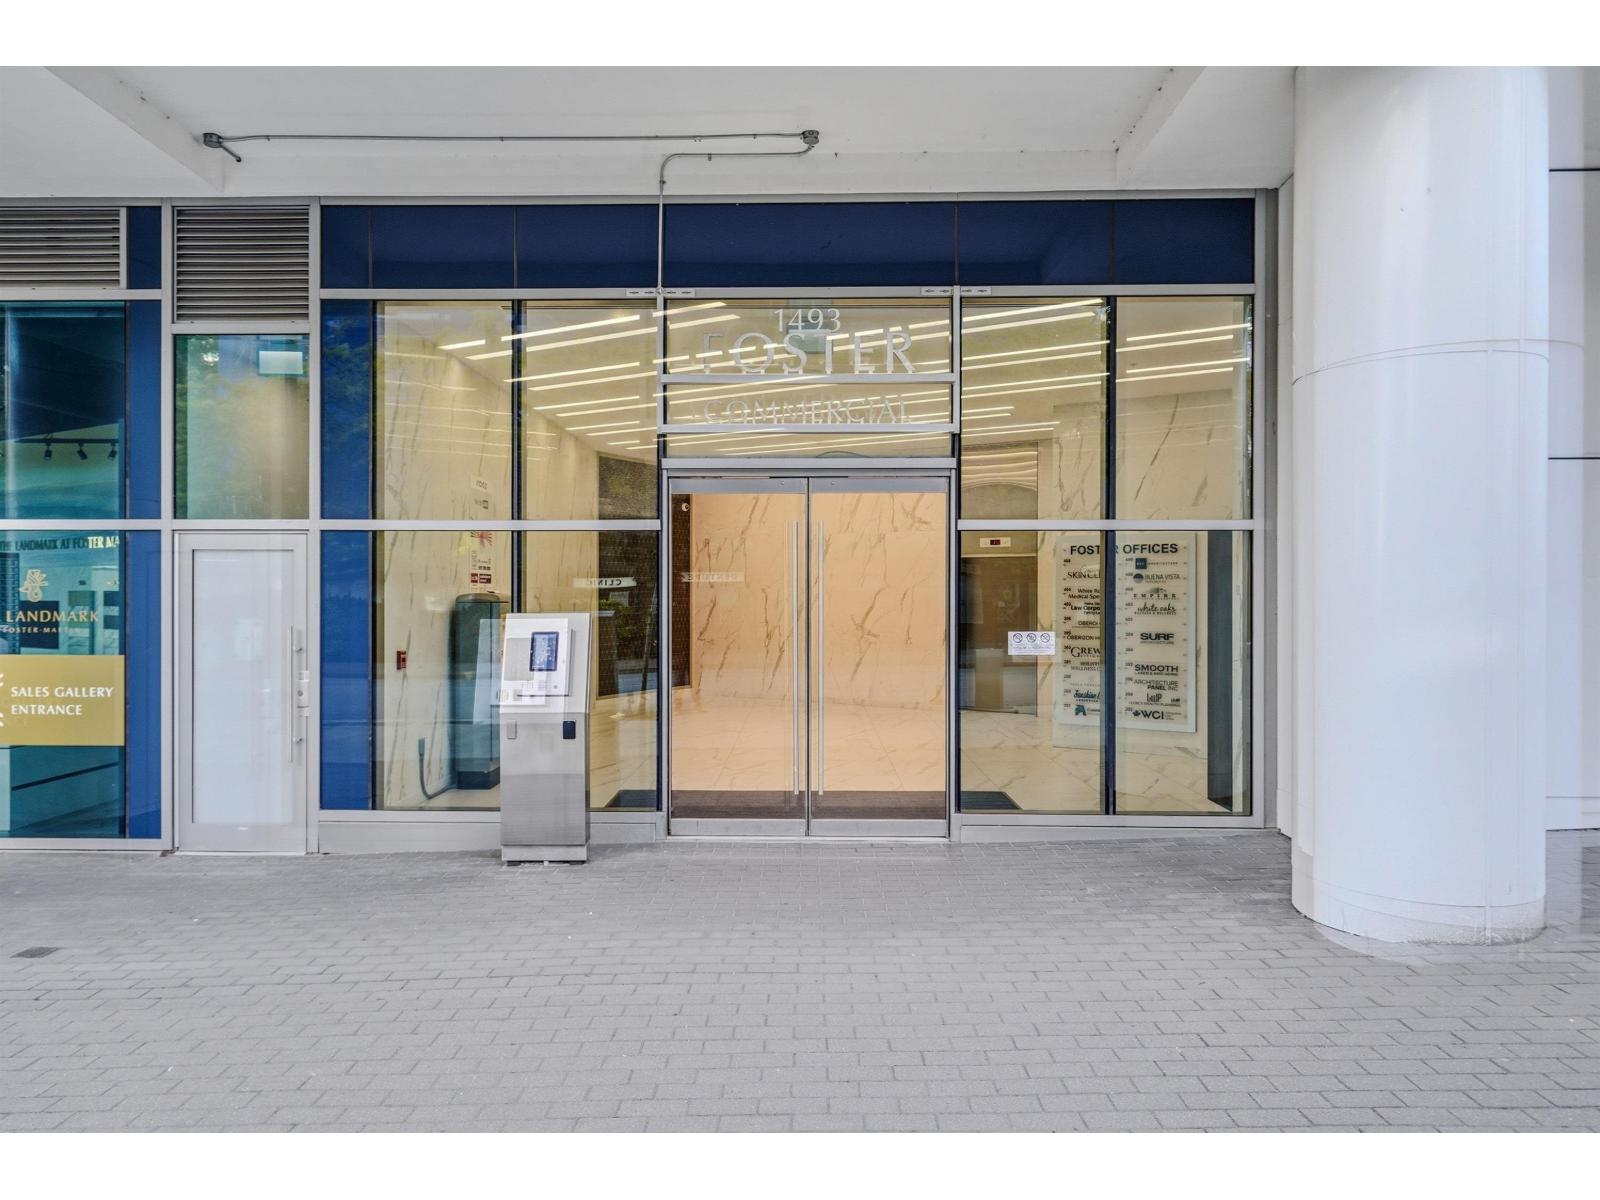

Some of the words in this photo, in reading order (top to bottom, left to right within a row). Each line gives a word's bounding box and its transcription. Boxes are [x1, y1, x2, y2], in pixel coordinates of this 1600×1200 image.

[774, 308, 841, 331] 1493
[703, 332, 915, 374] FOSTER
[703, 400, 911, 423] COMMERCIAL
[1122, 543, 1179, 554] OFFICES
[6, 610, 99, 622] LANDMARK
[1140, 632, 1175, 640] SURF
[1070, 646, 1101, 657] GREW
[1134, 664, 1179, 672] SMOOTH
[10, 686, 50, 697] SALES
[54, 686, 114, 697] GALLERY
[10, 704, 83, 716] ENTRANCE
[1141, 710, 1164, 720] WCI
